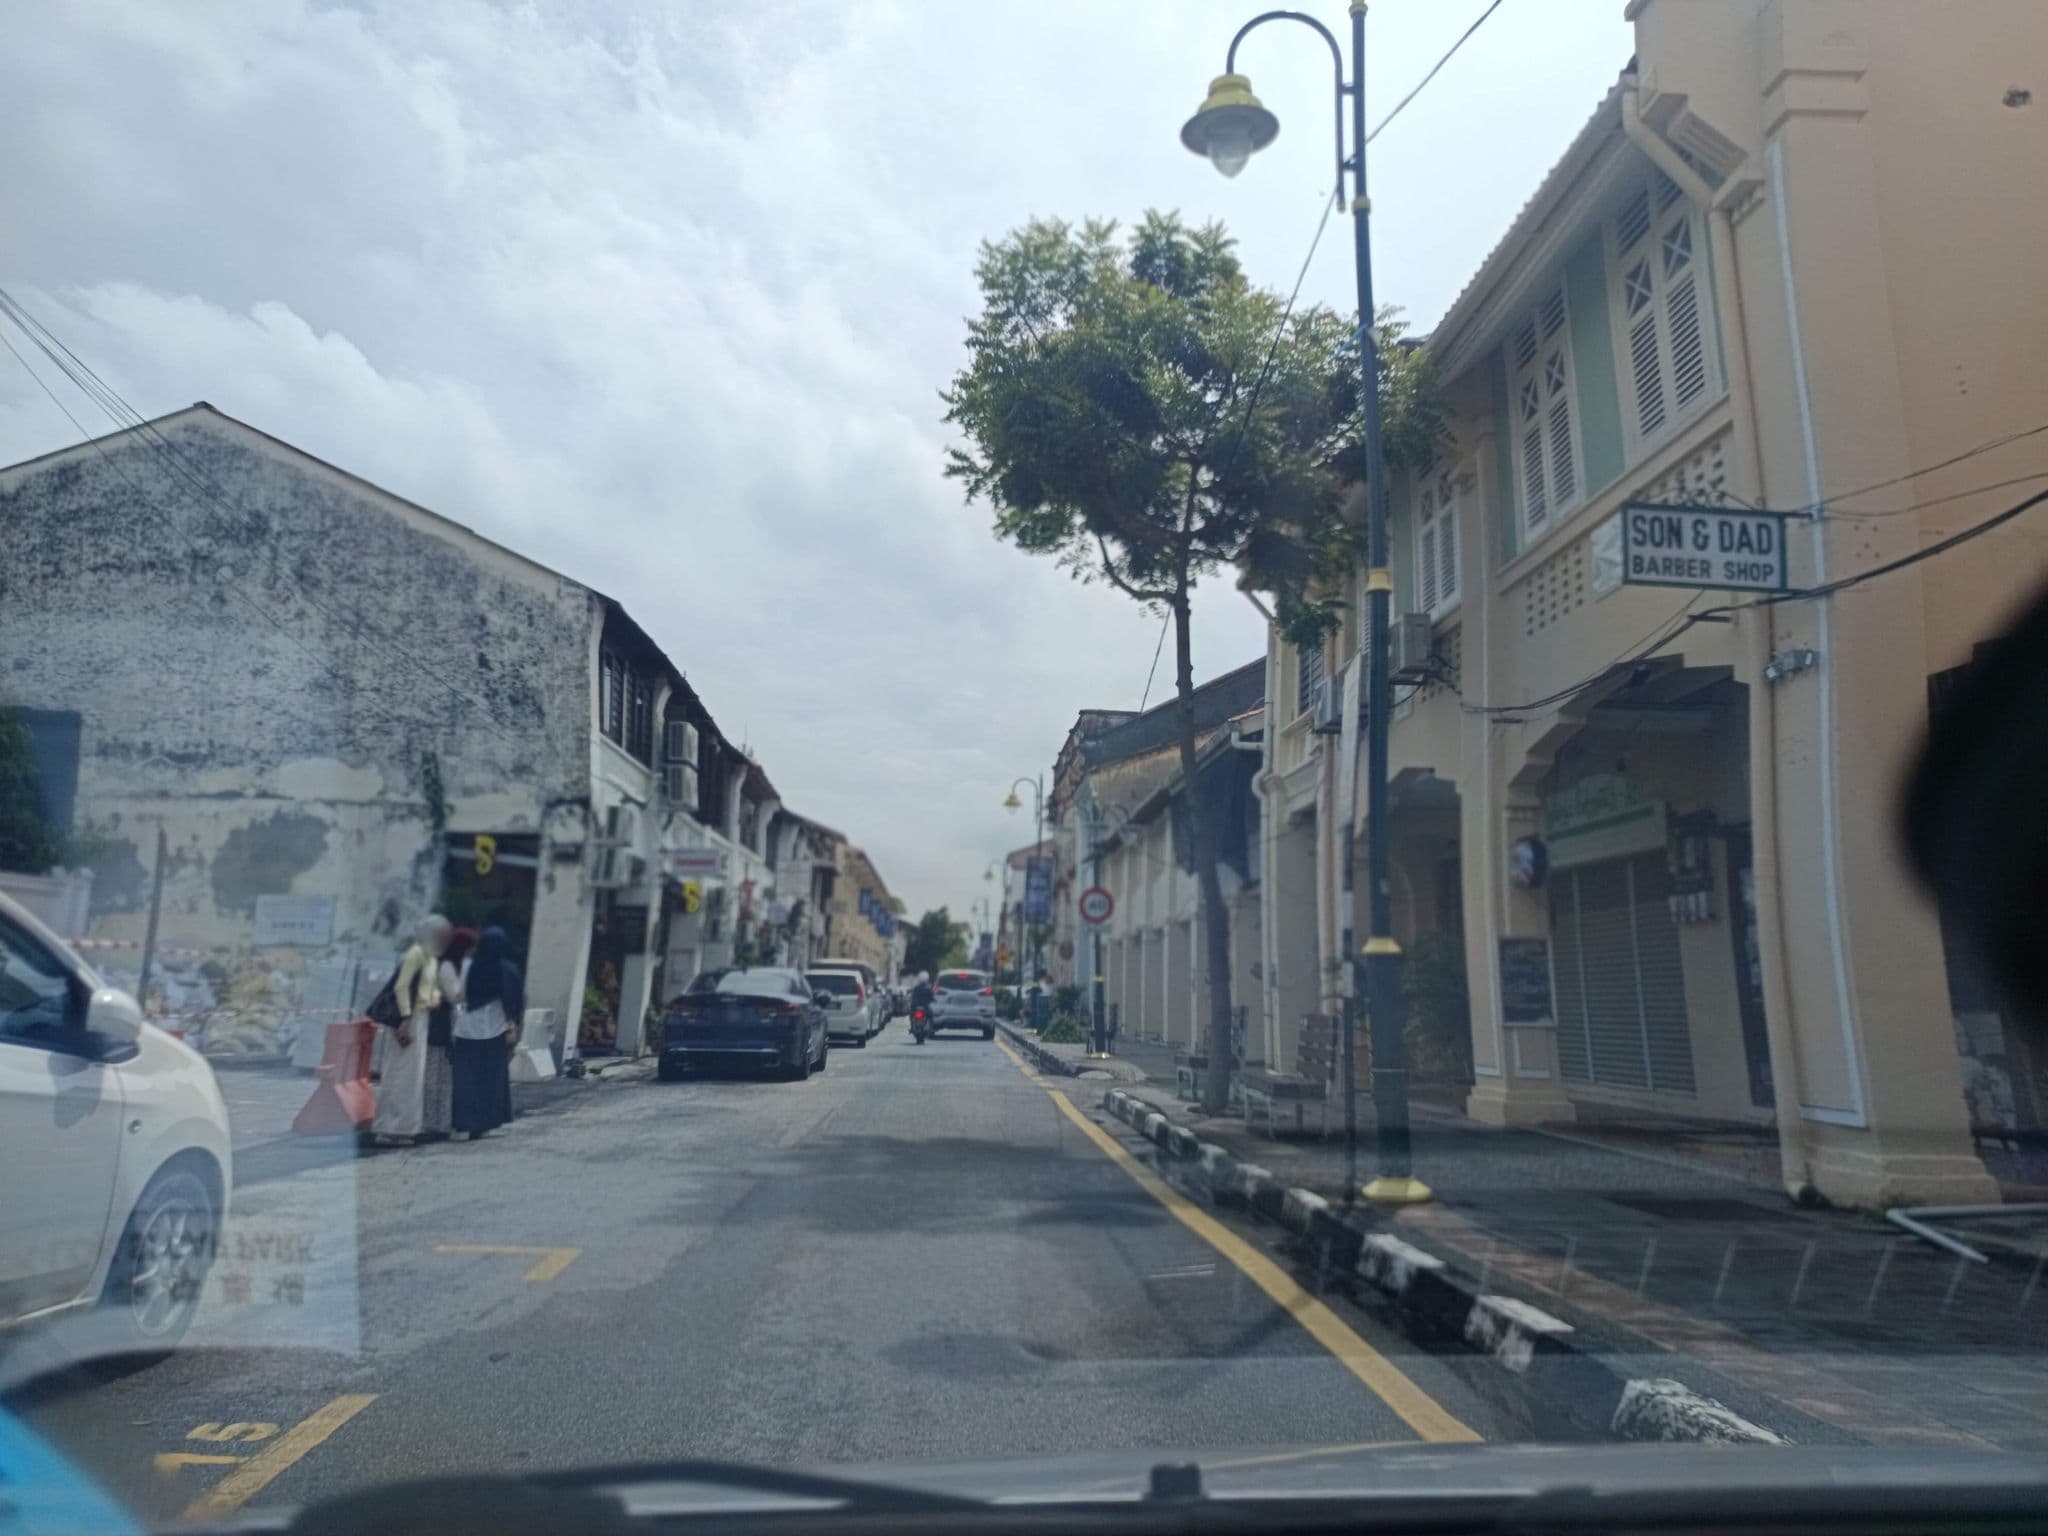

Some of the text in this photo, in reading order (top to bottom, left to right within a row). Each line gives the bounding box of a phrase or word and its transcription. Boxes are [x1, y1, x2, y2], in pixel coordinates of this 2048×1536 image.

[1631, 515, 1772, 555] SON & DAD
[1632, 555, 1774, 583] BARBER SHOP
